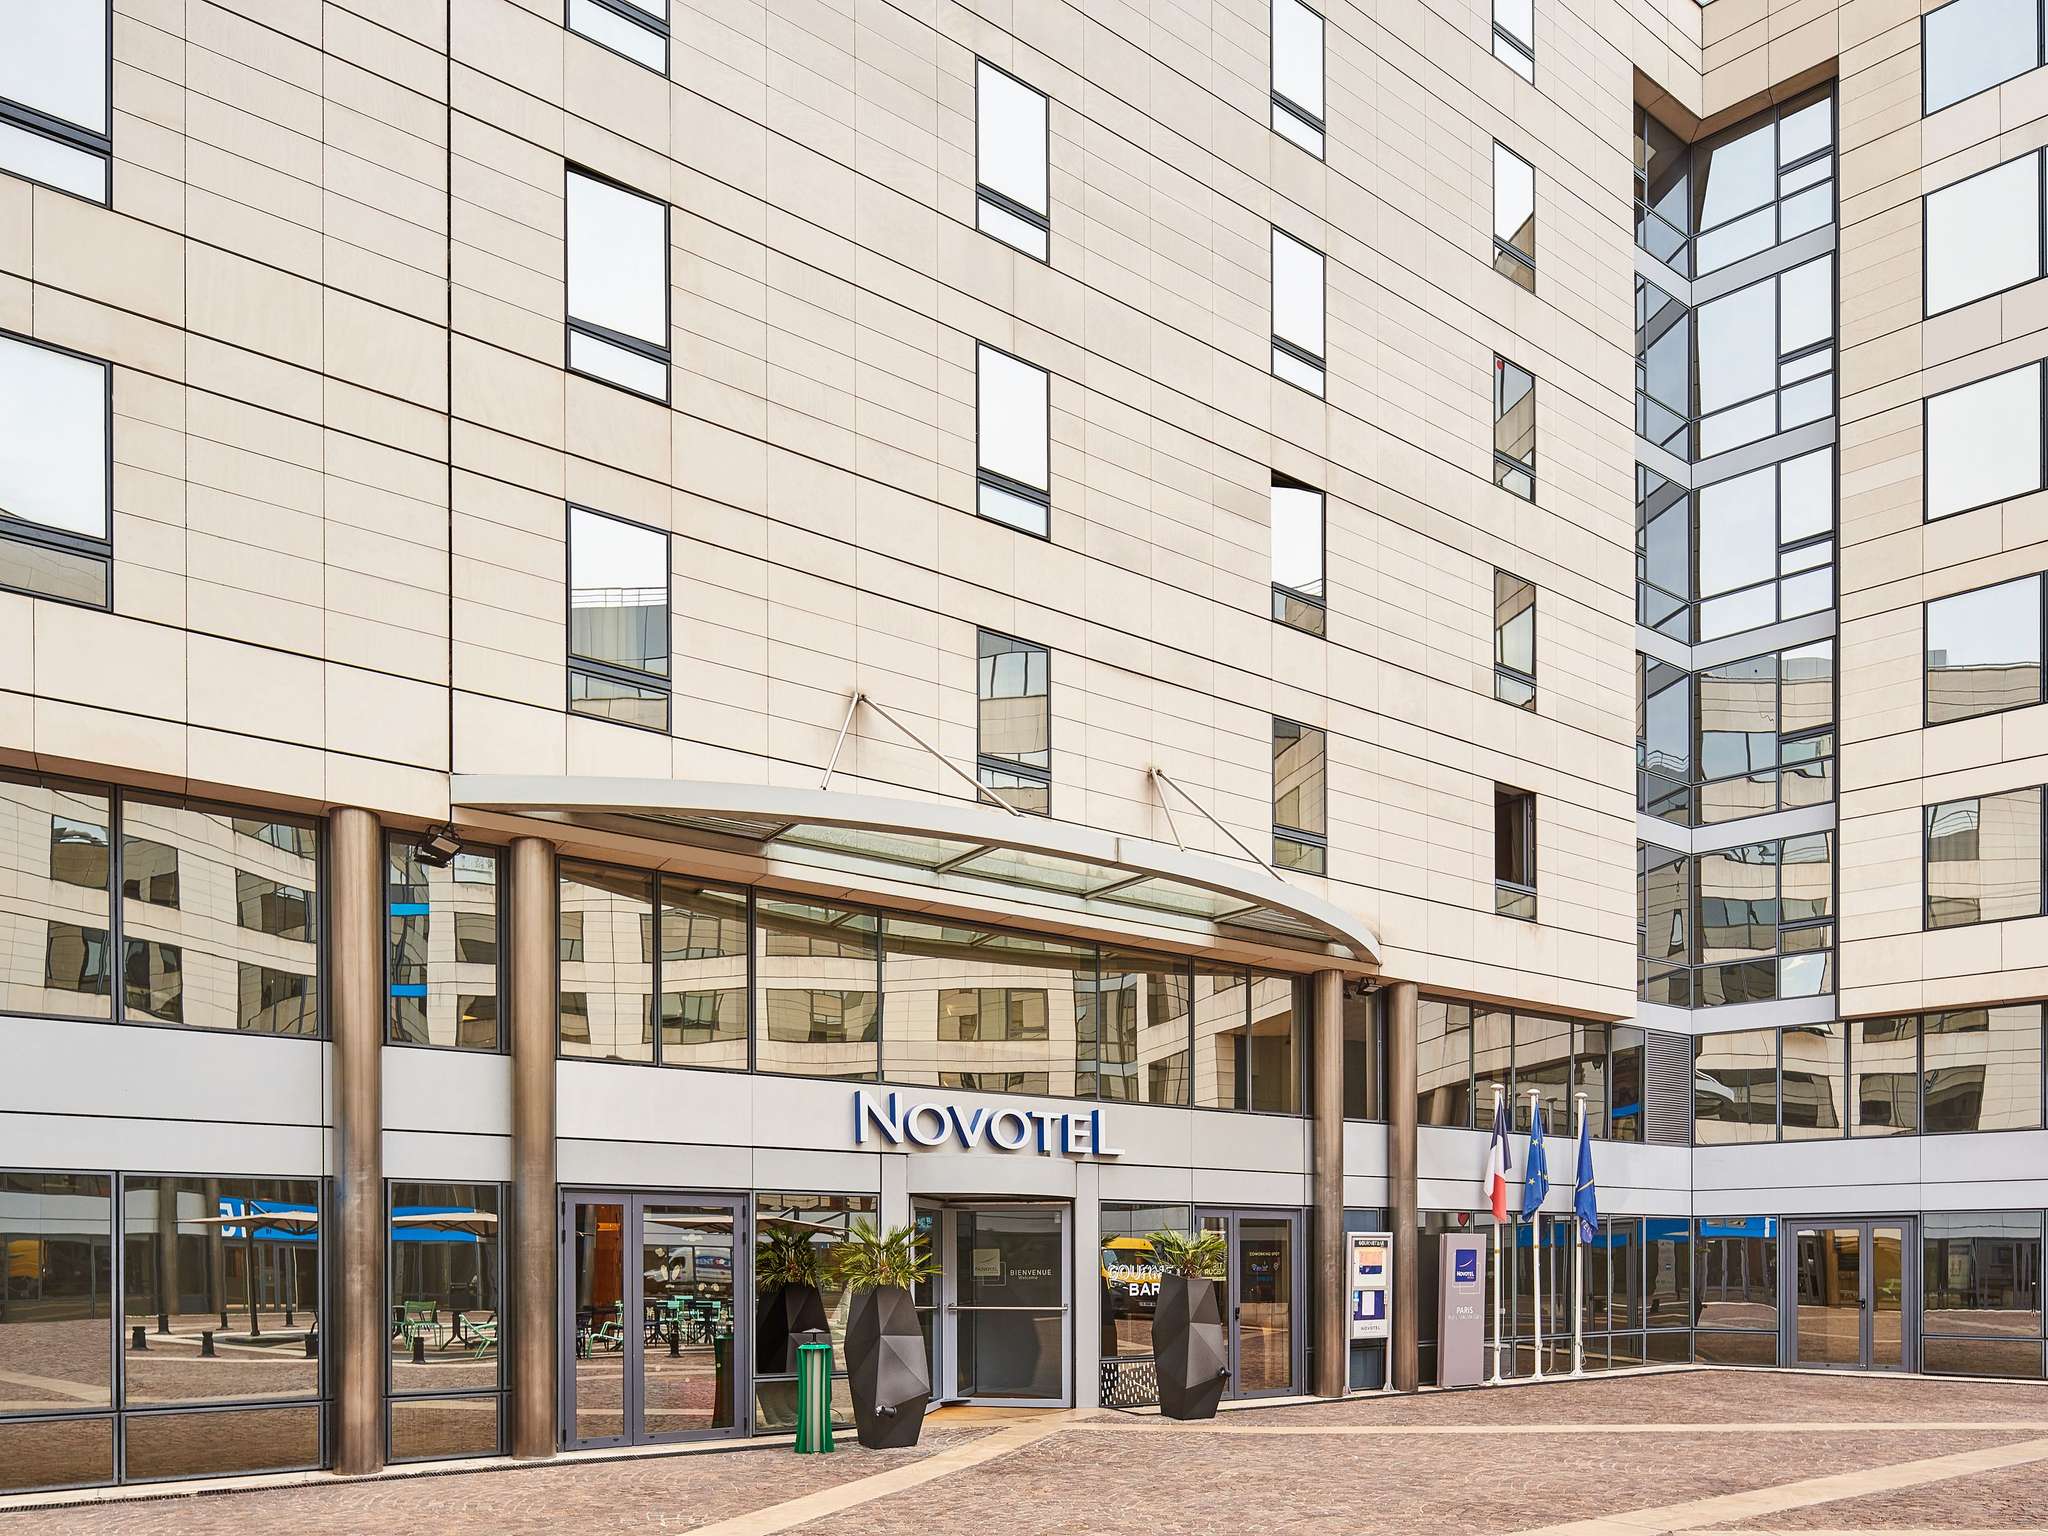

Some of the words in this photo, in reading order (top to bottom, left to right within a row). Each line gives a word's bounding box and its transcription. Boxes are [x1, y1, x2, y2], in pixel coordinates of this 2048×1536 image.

[854, 1088, 1126, 1157] NOVOTEL
[1129, 1283, 1161, 1297] BAR
[1456, 1306, 1474, 1314] PARIS
